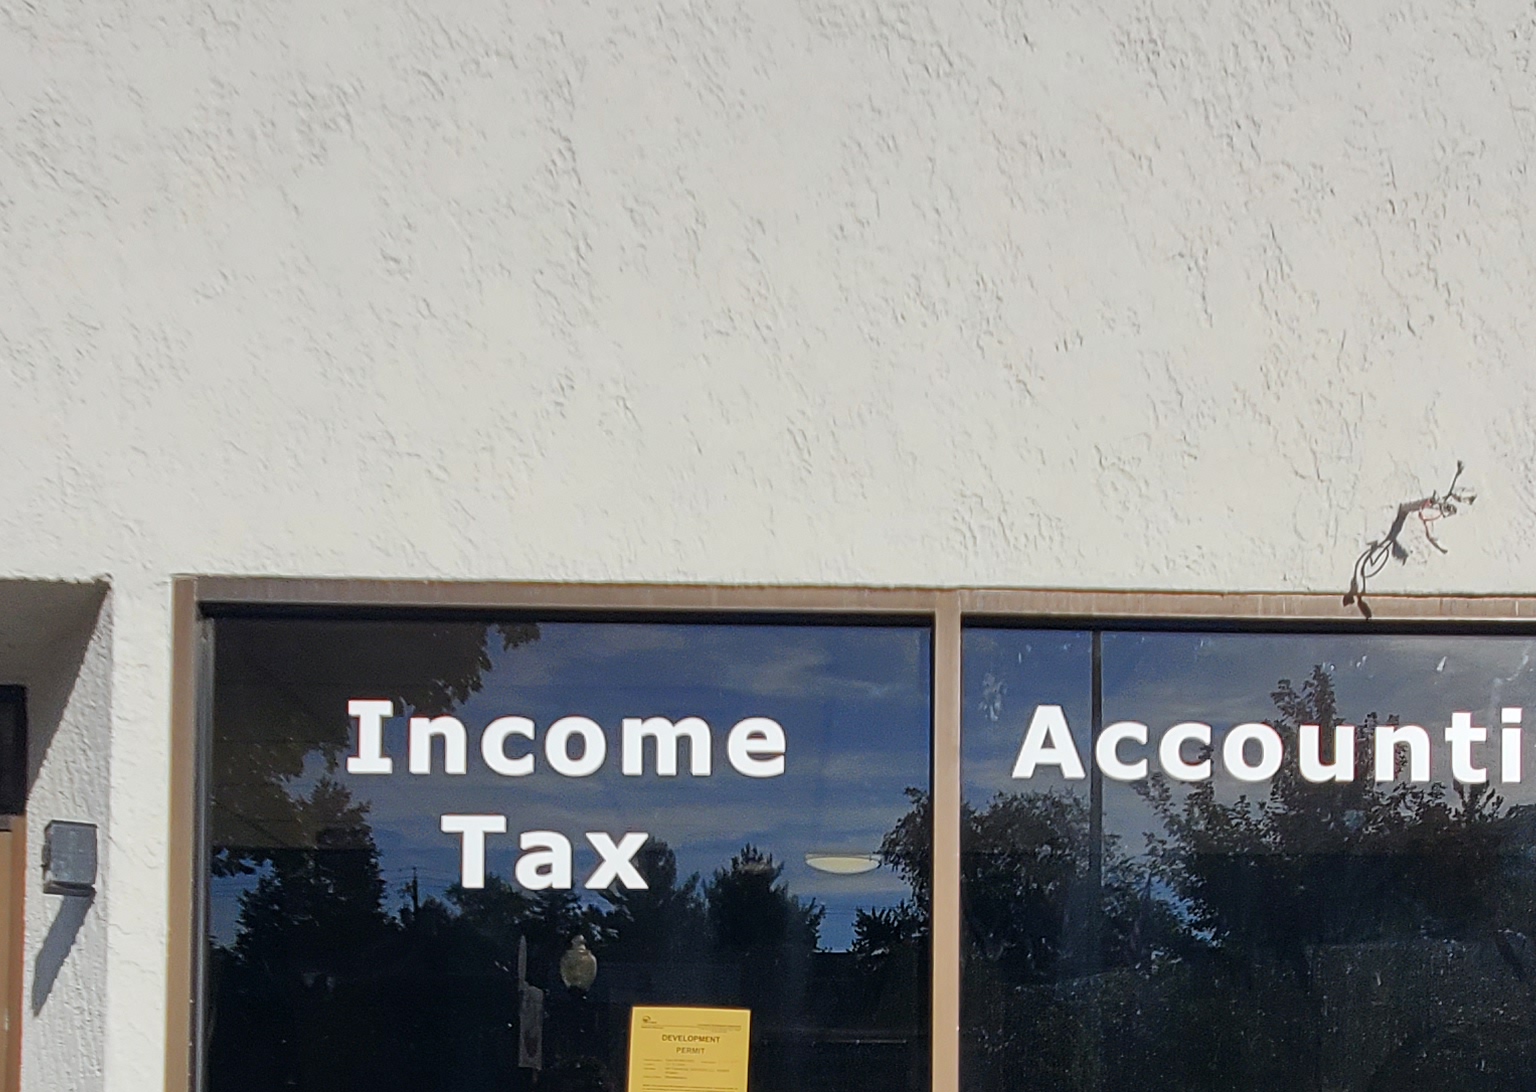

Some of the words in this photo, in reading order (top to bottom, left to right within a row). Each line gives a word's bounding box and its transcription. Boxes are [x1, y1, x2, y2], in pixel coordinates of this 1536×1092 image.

[346, 699, 787, 778] Income
[440, 814, 650, 891] Tax
[662, 1034, 720, 1043] DEVELOPMENT
